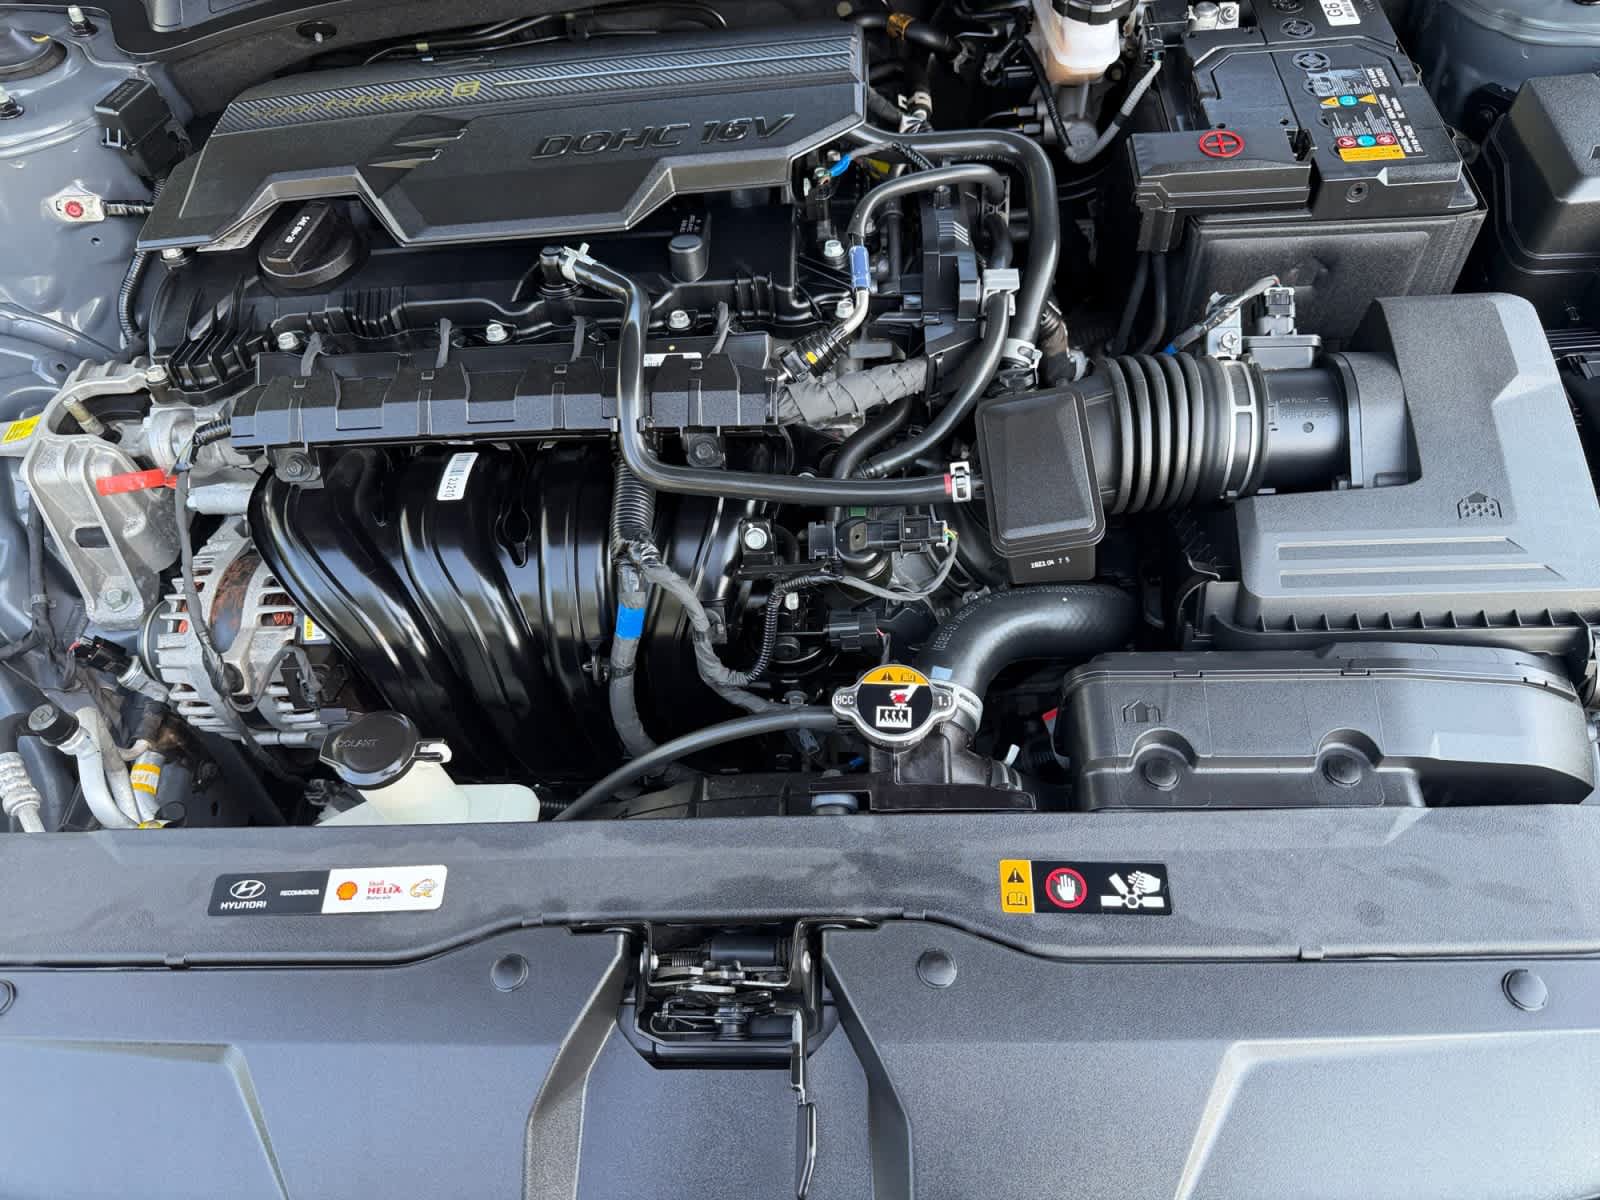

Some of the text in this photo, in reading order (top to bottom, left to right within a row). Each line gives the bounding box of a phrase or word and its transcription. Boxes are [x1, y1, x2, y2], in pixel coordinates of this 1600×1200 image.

[531, 113, 795, 160] DOHC 16V
[835, 695, 854, 705] HCC
[368, 884, 402, 895] HELIX
[220, 900, 267, 911] HYUNDAI
